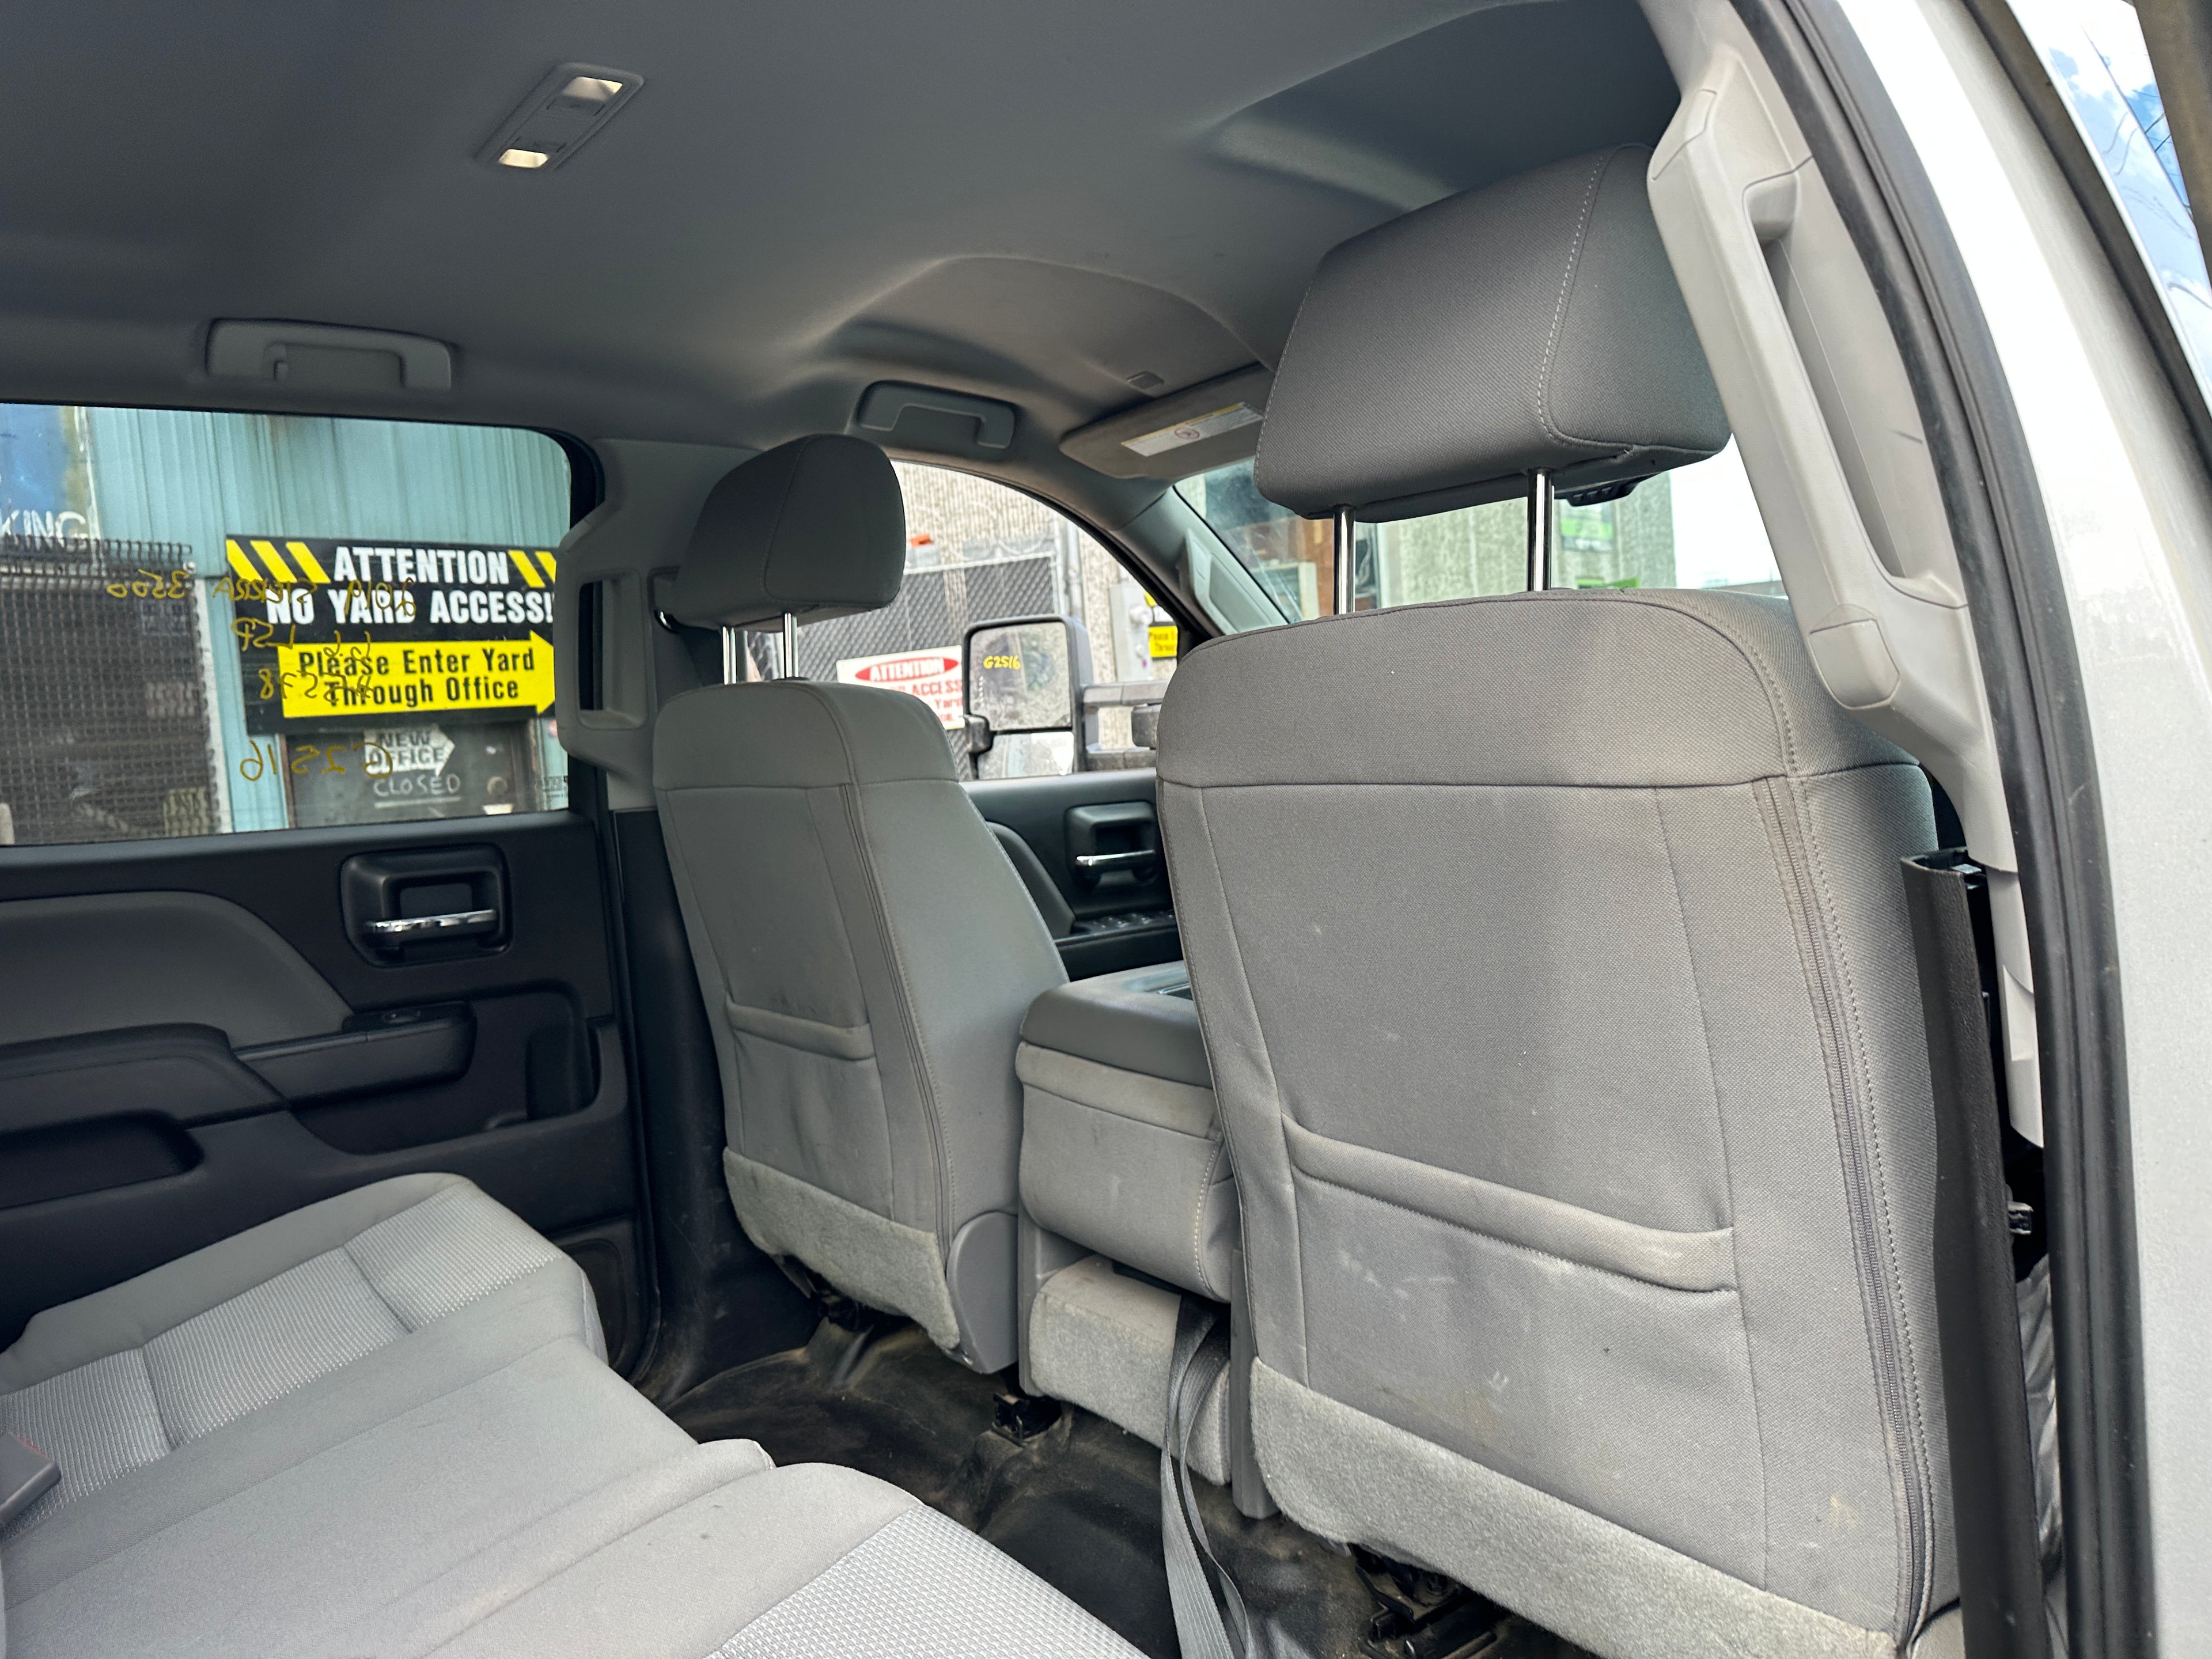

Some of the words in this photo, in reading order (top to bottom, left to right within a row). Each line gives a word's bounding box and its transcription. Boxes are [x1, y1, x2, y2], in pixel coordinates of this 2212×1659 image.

[334, 546, 509, 585] ATTENTION
[264, 588, 315, 625] NO
[327, 589, 416, 624] YARD
[429, 590, 555, 624] ACCESS!
[298, 651, 390, 677] Please
[403, 649, 470, 673] Enter
[482, 647, 535, 672] Yard
[870, 657, 945, 682] ATTENTION
[323, 677, 434, 708] Through
[445, 676, 519, 702] Office
[380, 730, 430, 747] NEW
[369, 748, 446, 766] OFFICE
[373, 773, 461, 798] CLOSED
